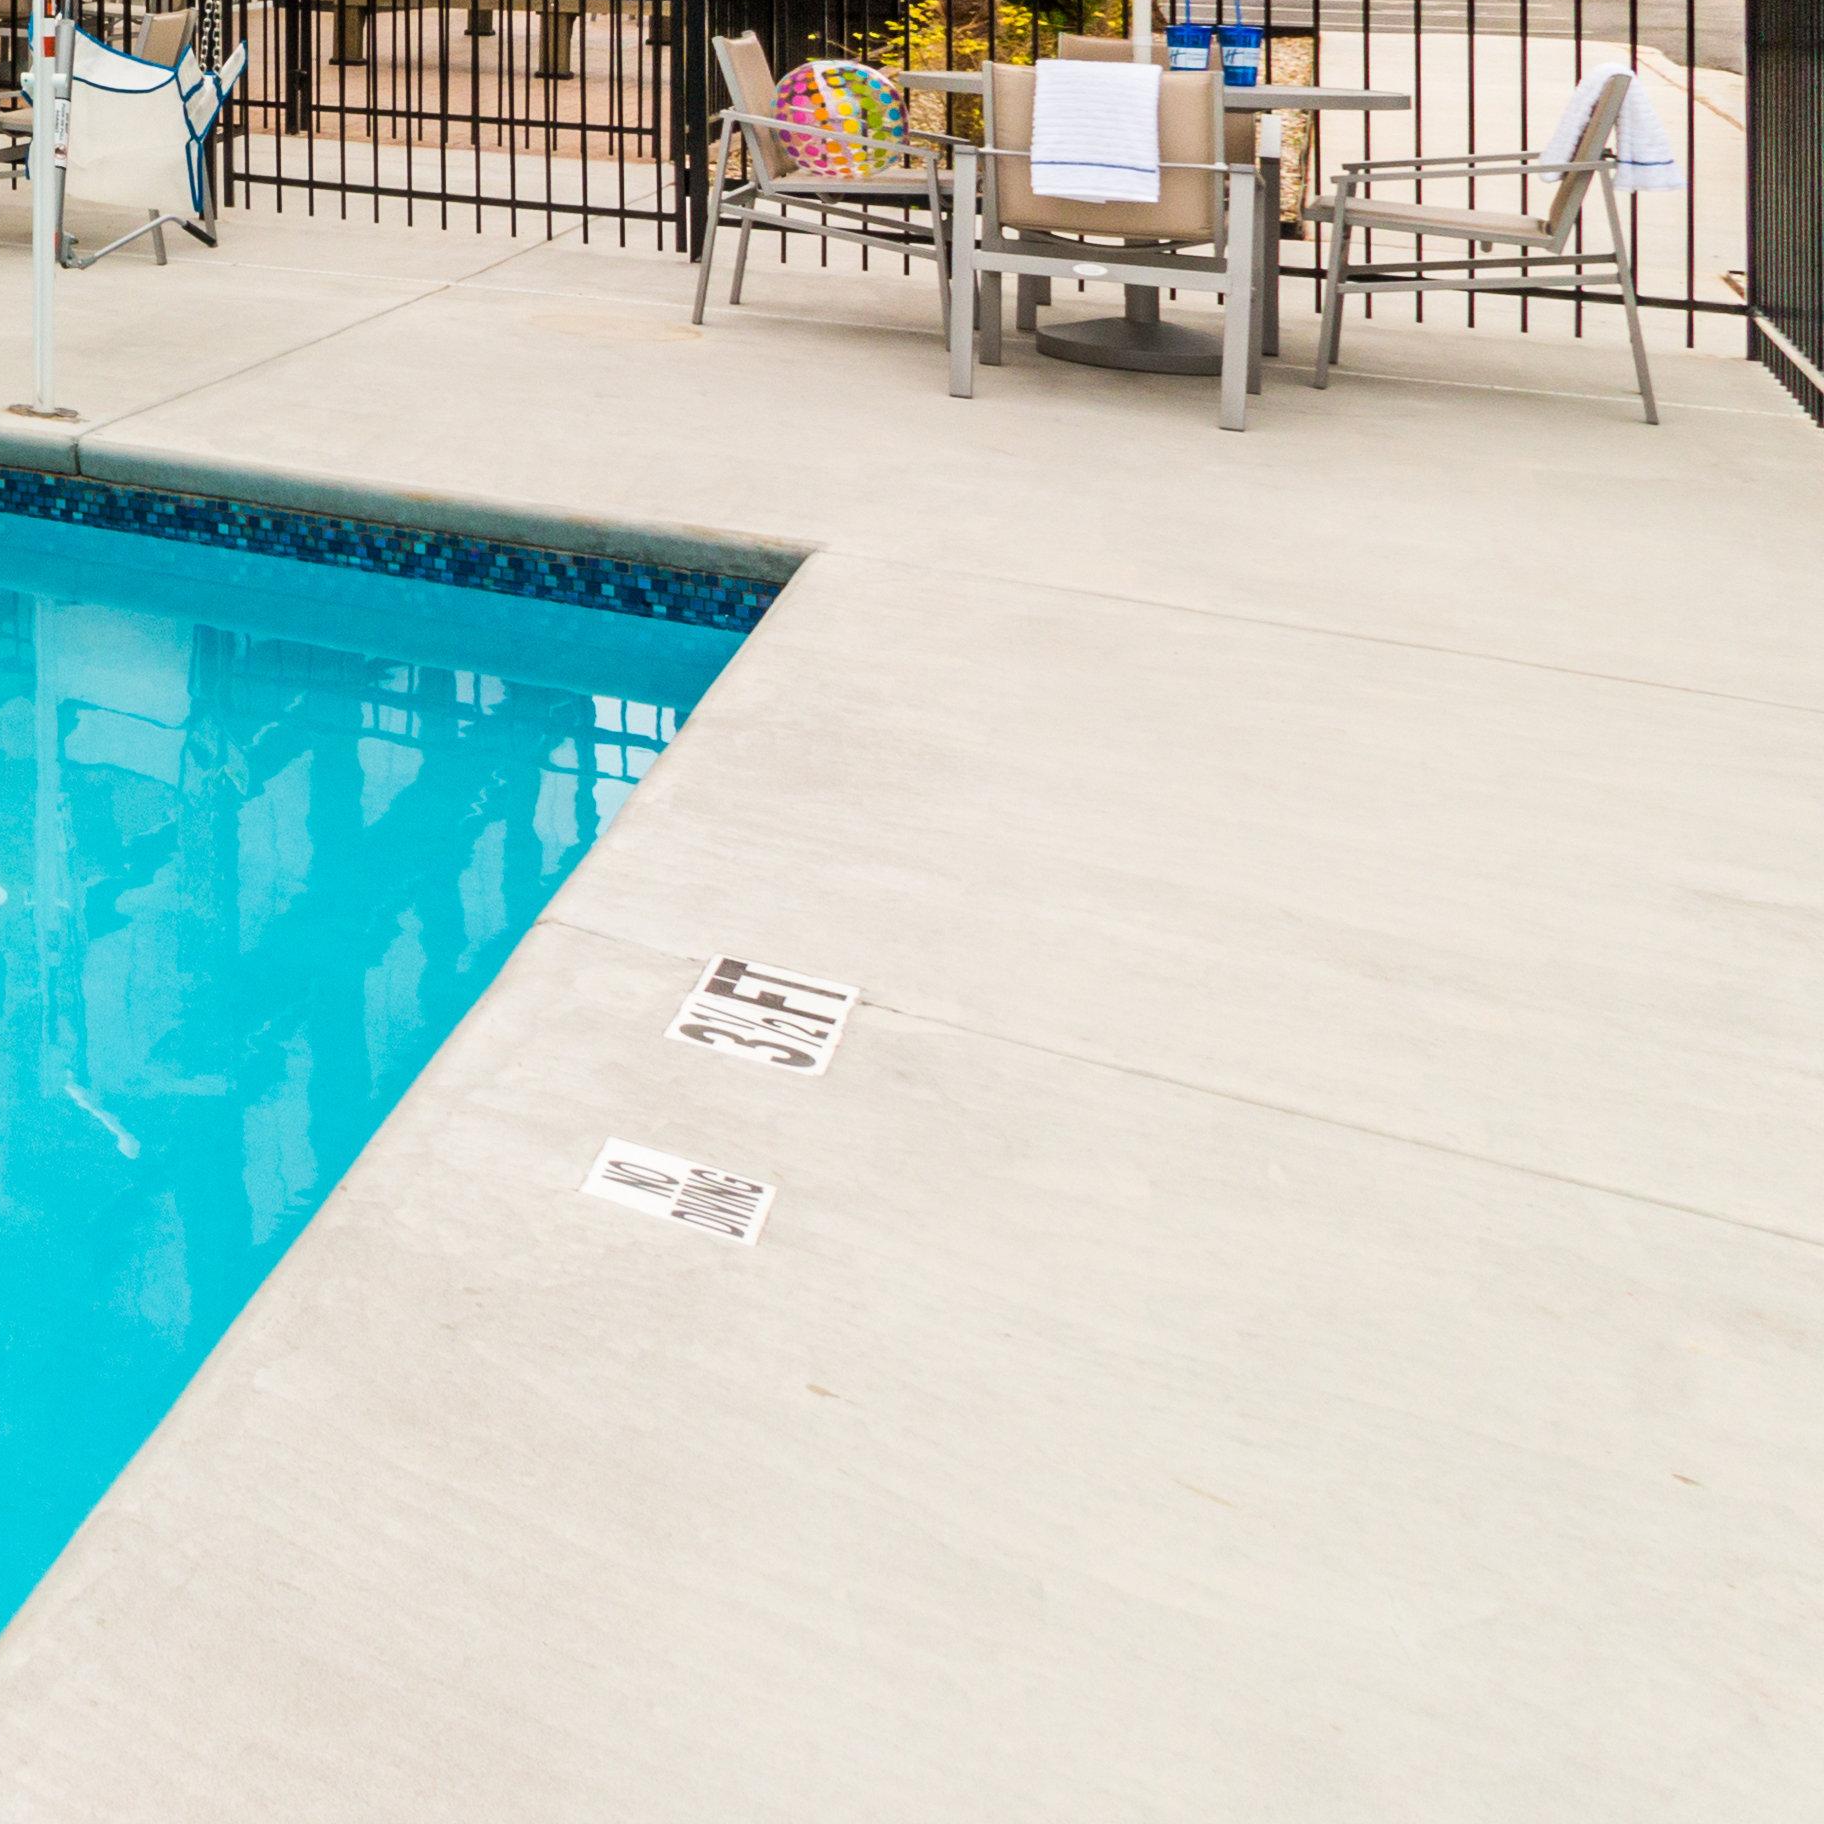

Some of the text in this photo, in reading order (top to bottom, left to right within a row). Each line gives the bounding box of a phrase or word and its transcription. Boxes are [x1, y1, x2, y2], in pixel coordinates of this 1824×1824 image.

[704, 957, 848, 1025] FT
[601, 1160, 680, 1199] NO
[670, 1168, 764, 1239] DIVING
